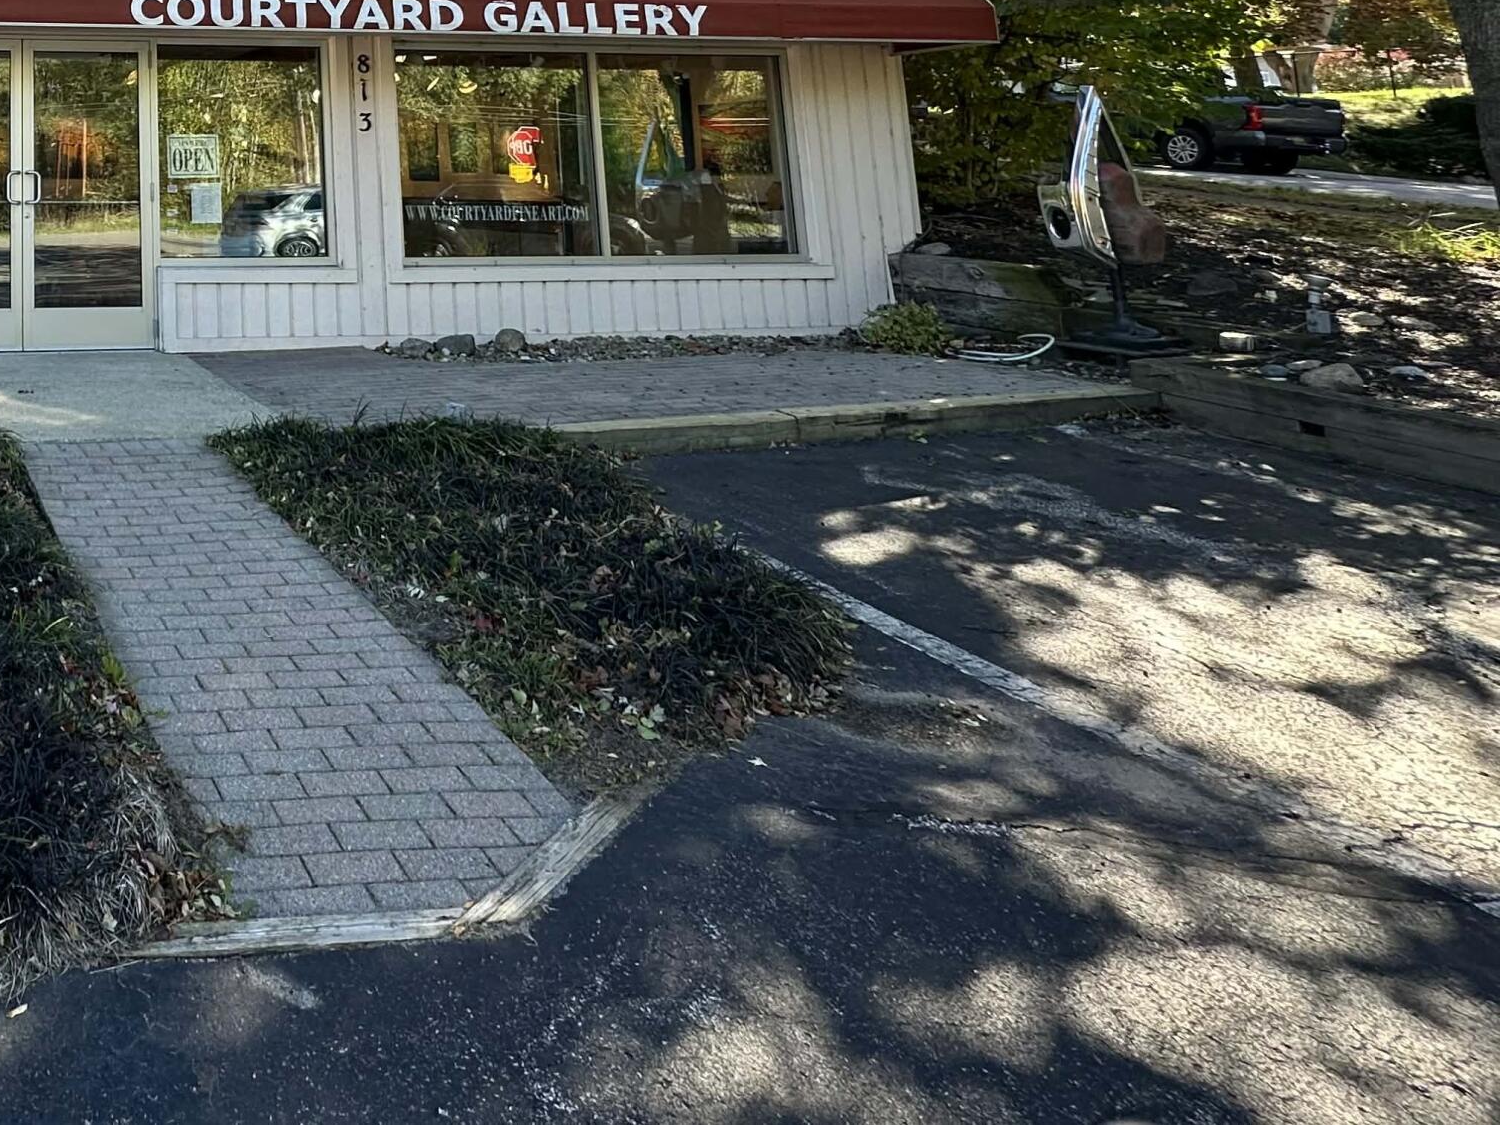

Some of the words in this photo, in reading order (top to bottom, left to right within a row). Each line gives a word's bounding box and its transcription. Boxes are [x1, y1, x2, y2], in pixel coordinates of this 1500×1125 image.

[484, 0, 708, 36] GALLERY
[357, 54, 372, 132] 813
[173, 148, 214, 172] OPEN
[405, 204, 589, 221] WWW.COURTYARDFINEART.COM
